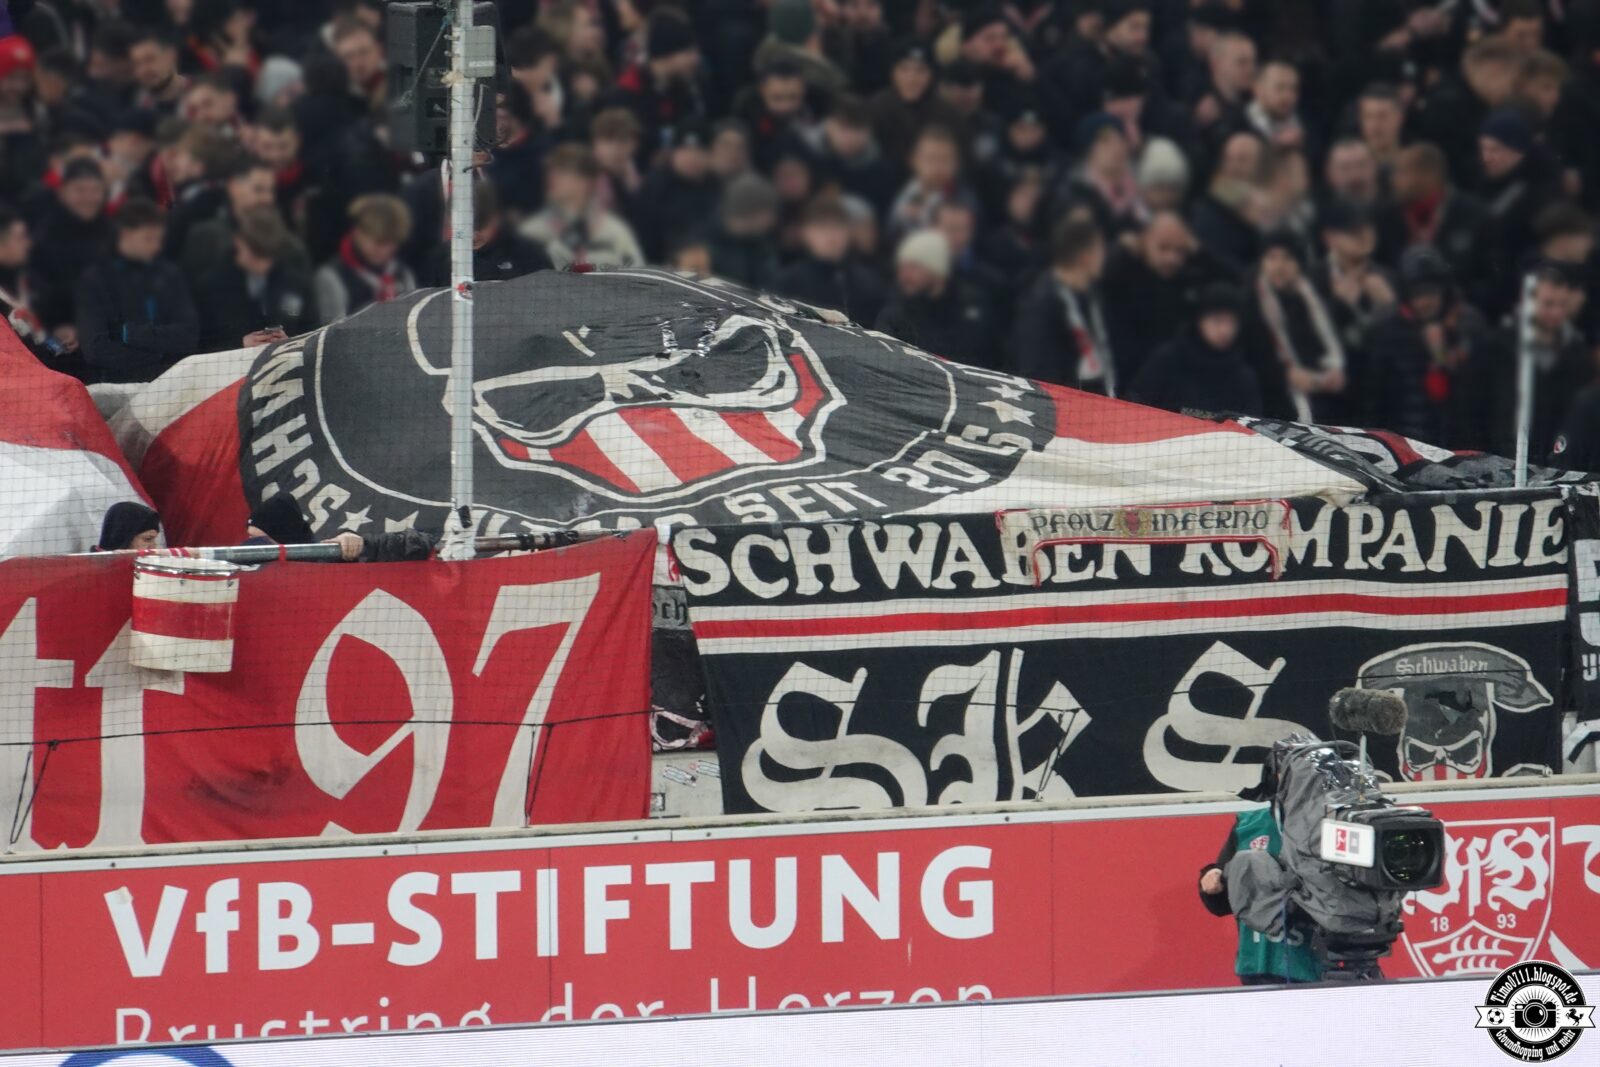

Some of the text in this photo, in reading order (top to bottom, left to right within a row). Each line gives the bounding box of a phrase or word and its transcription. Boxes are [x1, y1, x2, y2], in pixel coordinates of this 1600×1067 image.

[724, 481, 888, 523] SEIT
[673, 522, 1151, 599] SCHWABEN
[1179, 500, 1567, 577] KOMPANIE
[1395, 655, 1489, 680] Schwaben
[295, 572, 600, 835] 97
[103, 844, 995, 978] VfB-STIFTUNG
[1430, 913, 1517, 932] 18 93
